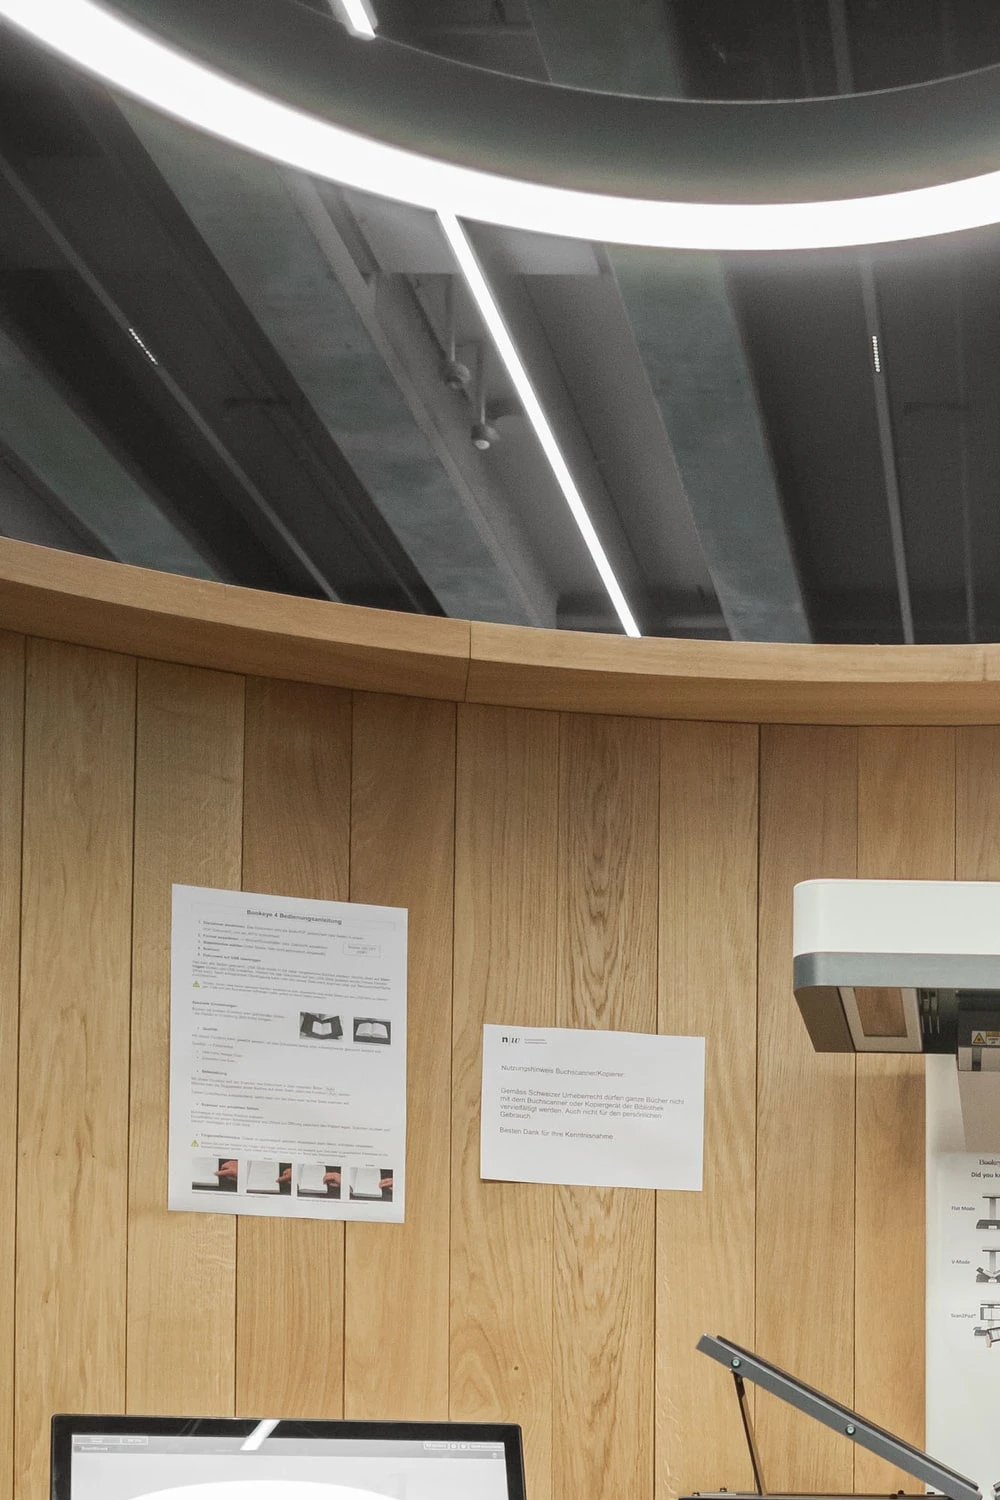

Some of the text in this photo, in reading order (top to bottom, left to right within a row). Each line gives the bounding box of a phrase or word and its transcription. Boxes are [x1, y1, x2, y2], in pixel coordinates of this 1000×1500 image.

[246, 909, 273, 918] Bookeye
[501, 1065, 554, 1074] Nutzungshinweis
[528, 1089, 561, 1097] Schweizer
[500, 1126, 521, 1135] Besten
[523, 1128, 539, 1136] Dank
[541, 1129, 550, 1137] für
